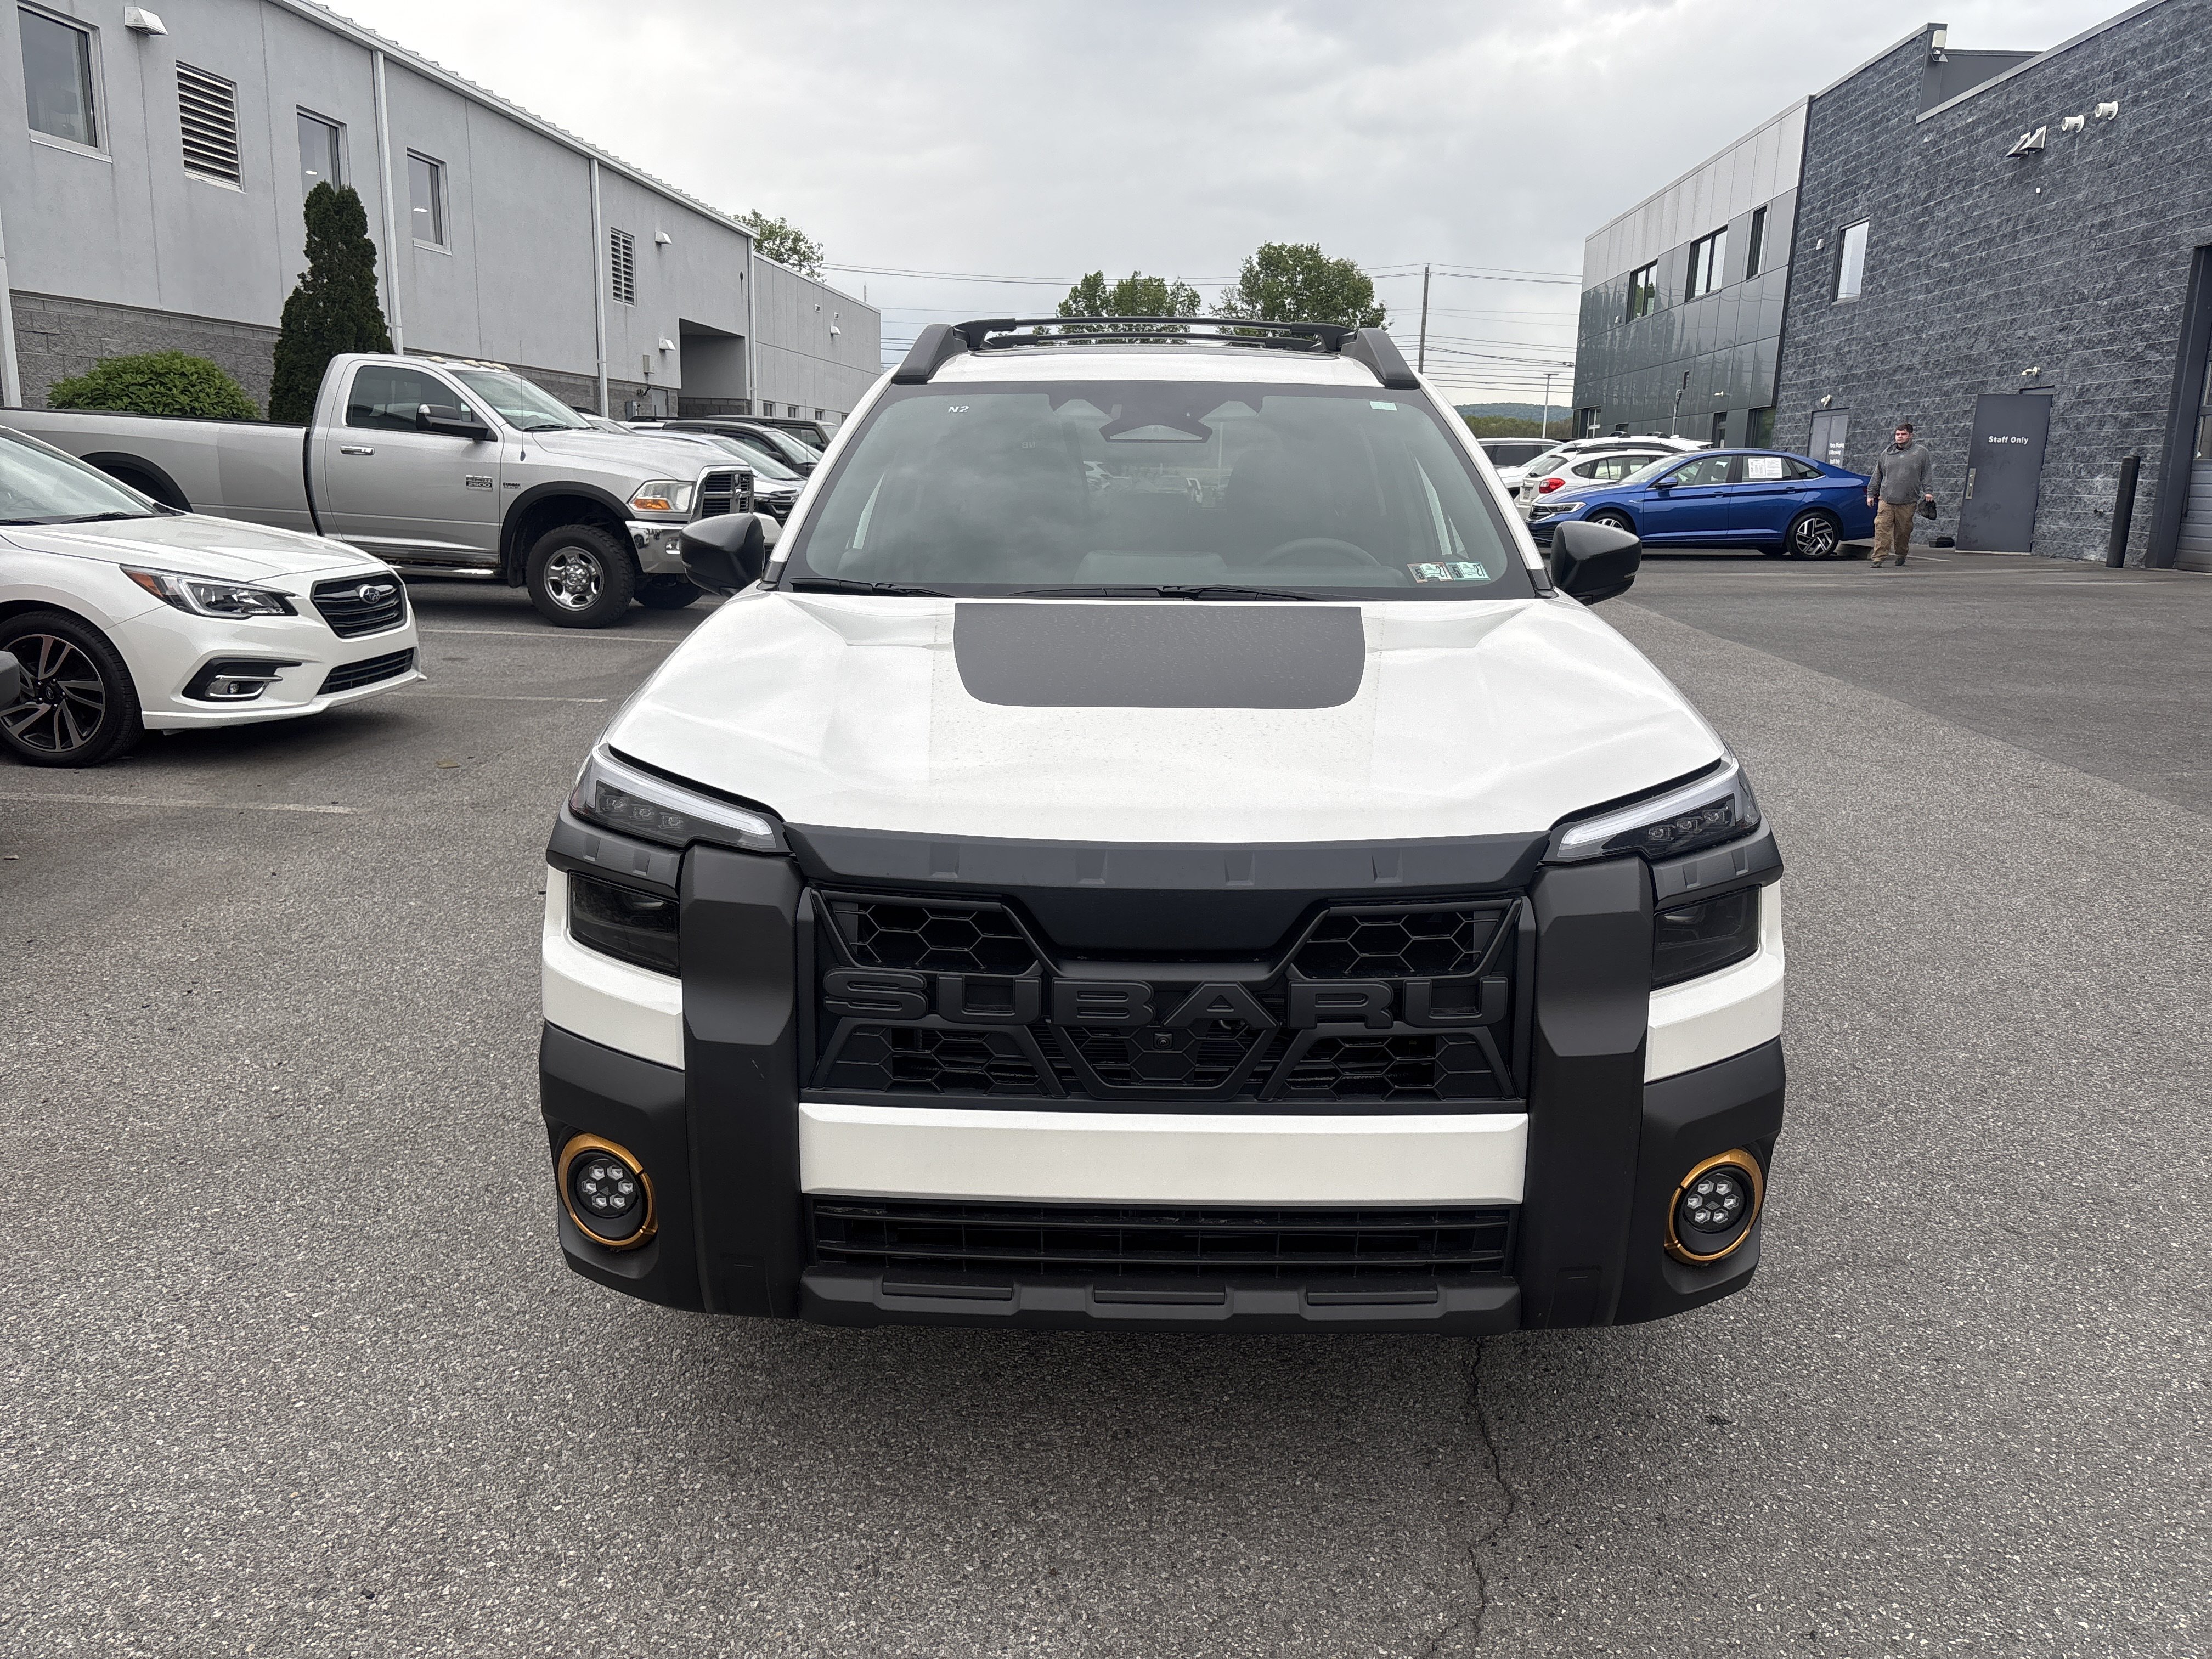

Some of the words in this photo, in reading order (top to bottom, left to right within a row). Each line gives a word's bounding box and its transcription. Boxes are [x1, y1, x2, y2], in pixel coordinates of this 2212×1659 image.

[2011, 436, 2029, 445] Only
[1415, 567, 1425, 580] 5
[1435, 565, 1448, 578] 27
[1452, 567, 1463, 578] 5
[1473, 564, 1485, 577] 27
[824, 968, 1508, 1029] SUBARU
